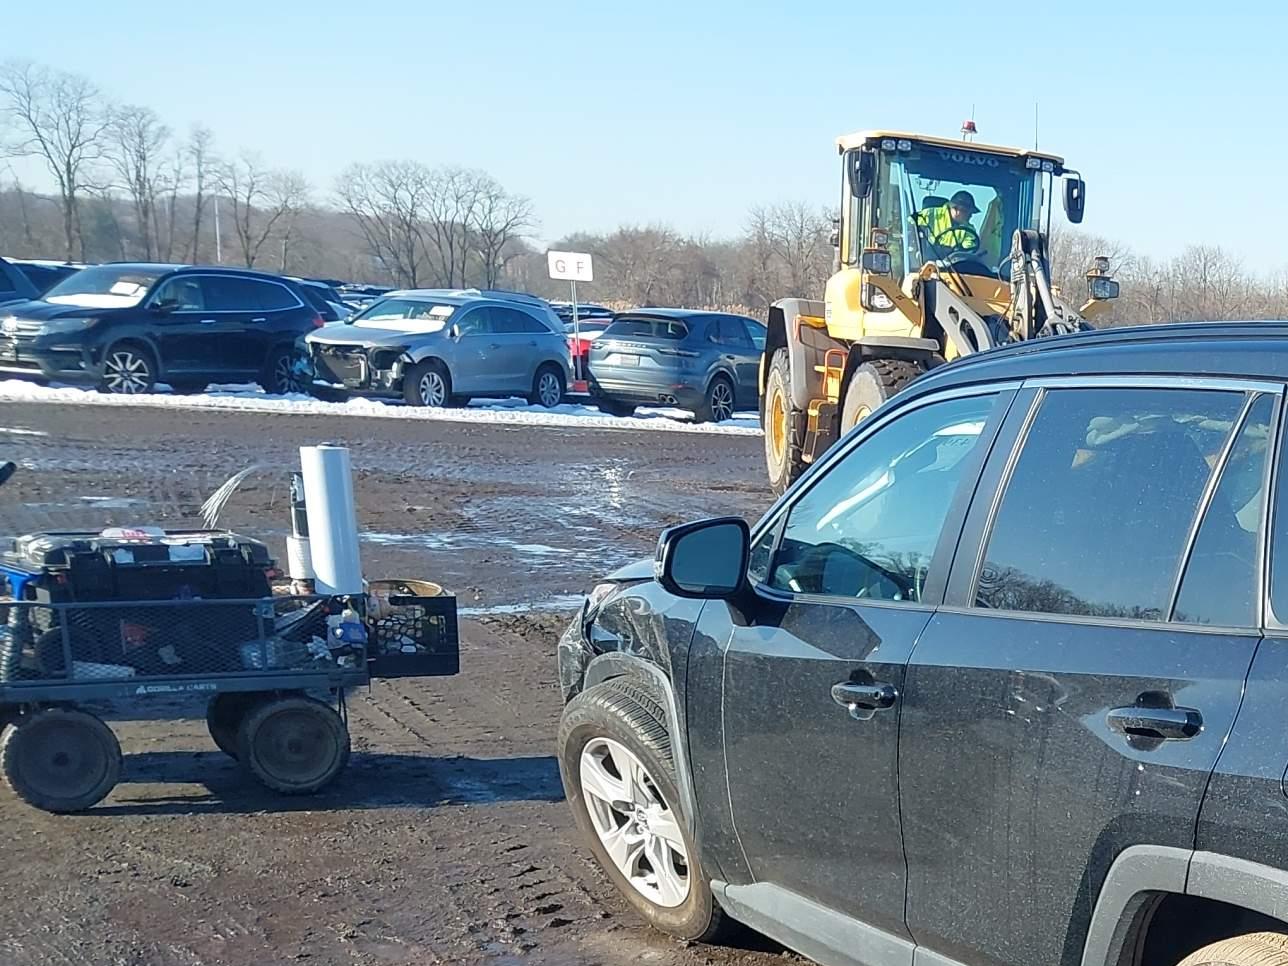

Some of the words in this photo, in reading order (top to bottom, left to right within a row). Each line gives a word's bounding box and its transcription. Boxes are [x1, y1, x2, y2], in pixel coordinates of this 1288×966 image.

[939, 151, 1000, 168] VOLVO
[555, 259, 566, 273] G
[576, 261, 585, 275] F
